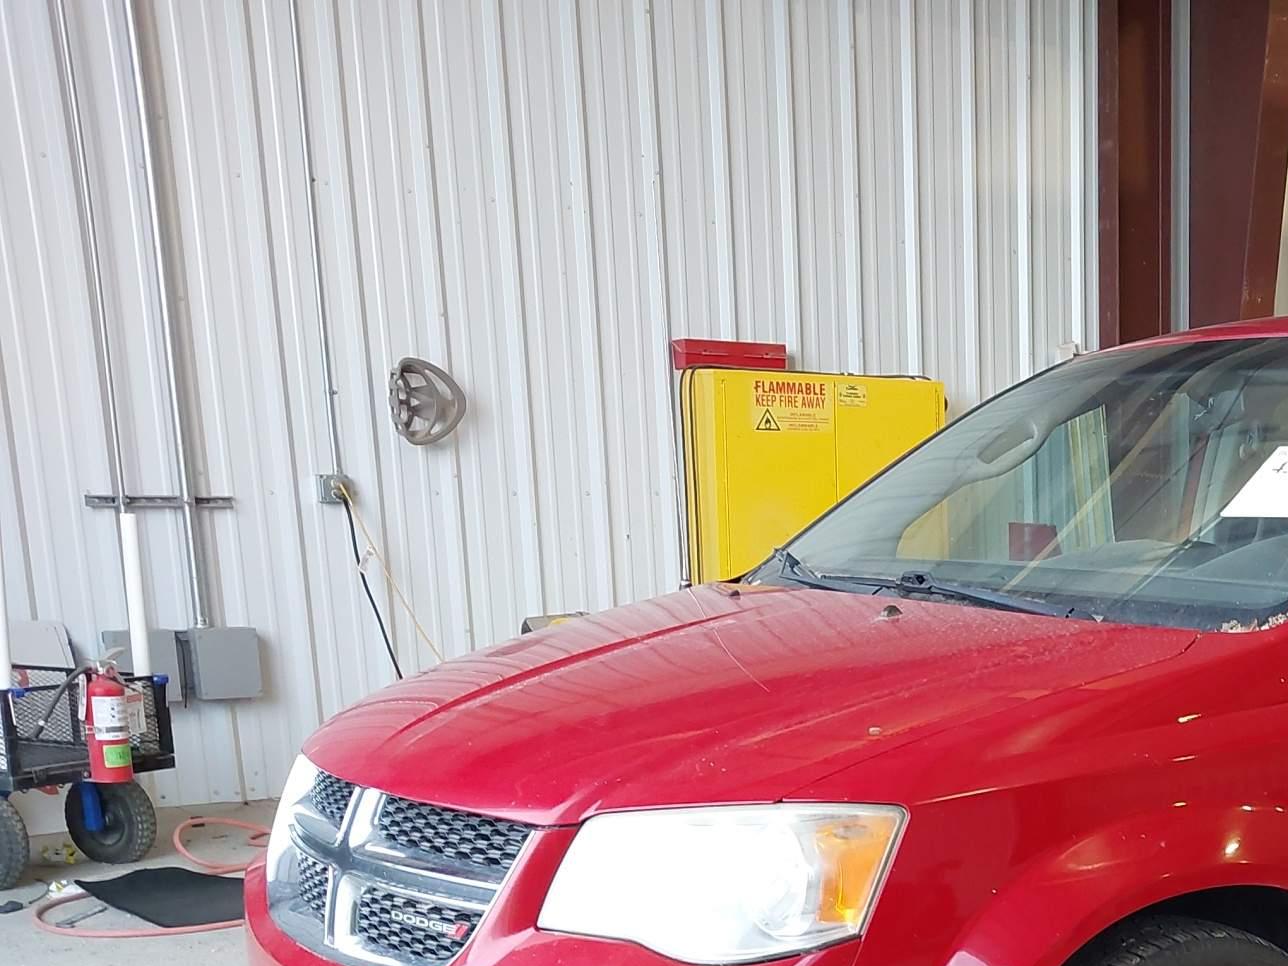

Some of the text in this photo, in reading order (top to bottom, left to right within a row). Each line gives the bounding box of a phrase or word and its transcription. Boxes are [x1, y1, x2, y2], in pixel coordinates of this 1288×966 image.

[754, 380, 826, 395] FLAMMABLE
[755, 394, 826, 409] KEEP FIRE AWAY
[391, 911, 456, 935] DODGE
